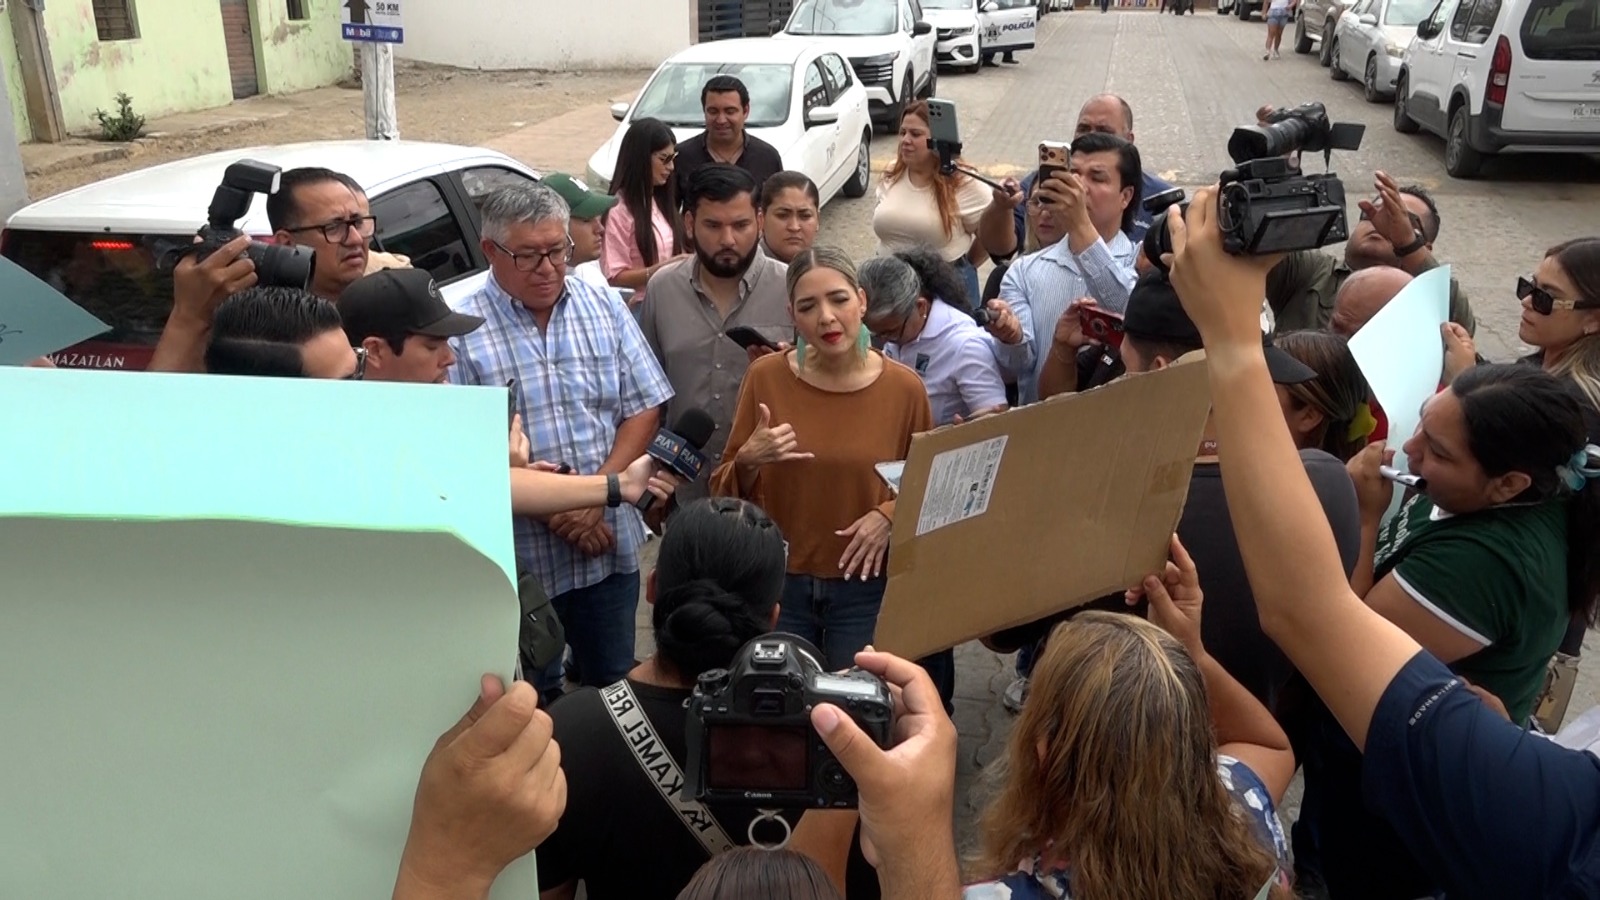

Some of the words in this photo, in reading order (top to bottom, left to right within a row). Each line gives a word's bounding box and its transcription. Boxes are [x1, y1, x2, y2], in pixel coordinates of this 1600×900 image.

[375, 2, 386, 11] 50
[386, 3, 399, 11] KM
[1002, 20, 1035, 31] POLICÍA
[48, 353, 125, 368] MAZATLÁN
[744, 790, 772, 798] Canon
